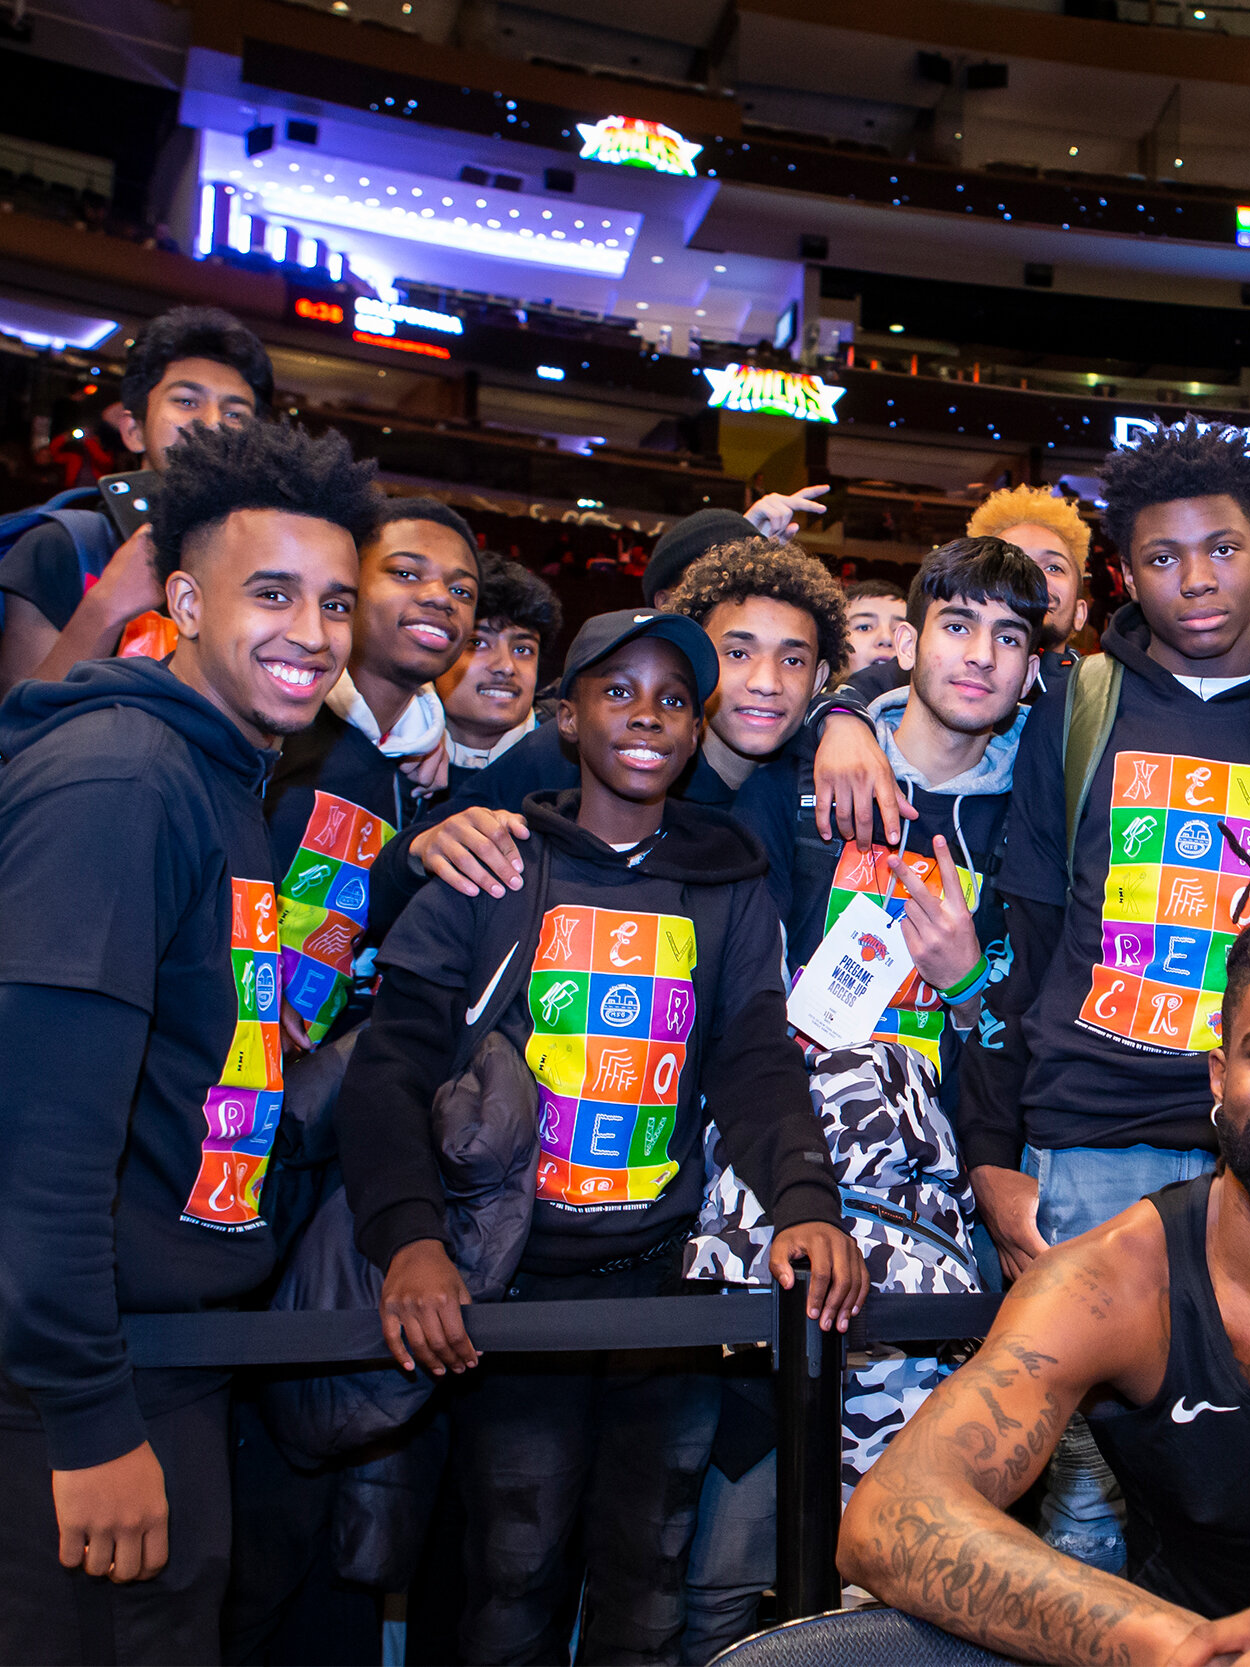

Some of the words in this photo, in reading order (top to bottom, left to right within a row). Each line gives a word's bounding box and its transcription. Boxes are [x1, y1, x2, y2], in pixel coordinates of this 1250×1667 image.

[718, 364, 828, 422] KNICKS
[831, 965, 868, 998] WARM-UP
[839, 954, 874, 987] PREGAME
[827, 980, 857, 1008] ACCESS
